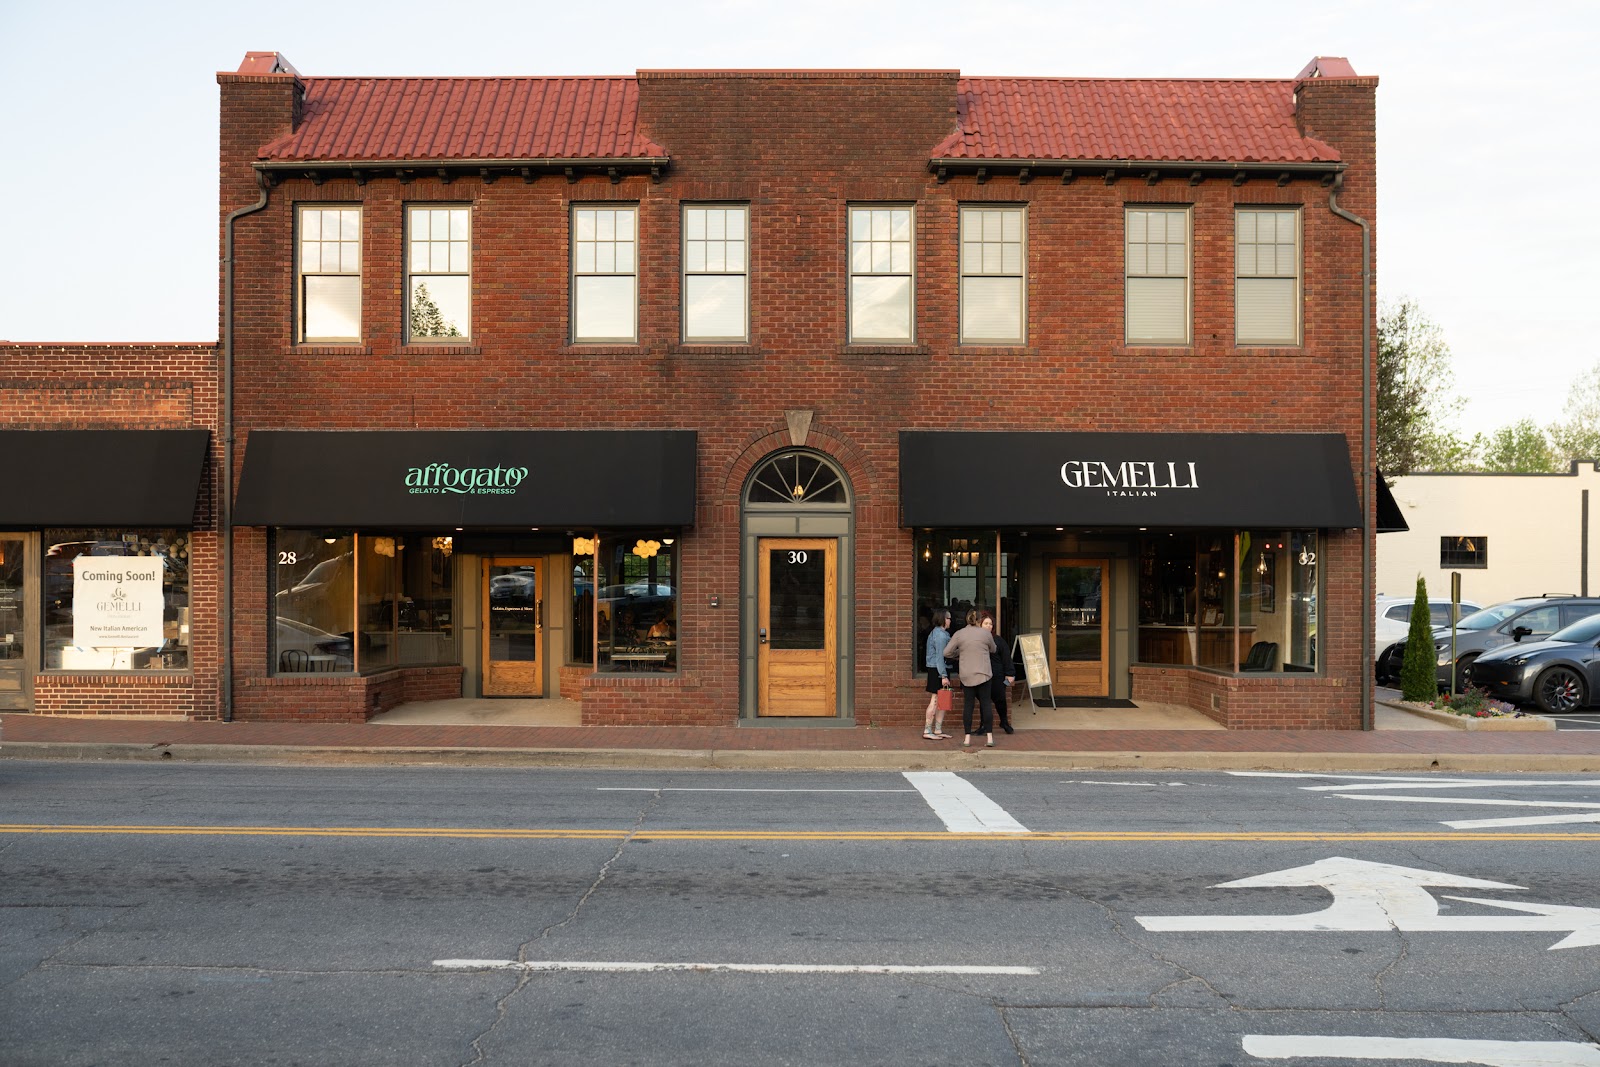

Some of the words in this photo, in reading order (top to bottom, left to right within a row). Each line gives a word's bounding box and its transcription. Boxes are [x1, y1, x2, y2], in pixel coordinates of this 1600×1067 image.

[404, 463, 529, 494] affogato
[1060, 460, 1199, 488] GEMELLI
[278, 551, 297, 565] 28
[787, 550, 808, 564] 30
[1298, 552, 1316, 566] 32
[82, 570, 123, 584] Coming
[125, 570, 156, 581] Soon!
[96, 602, 141, 612] GEMELLI
